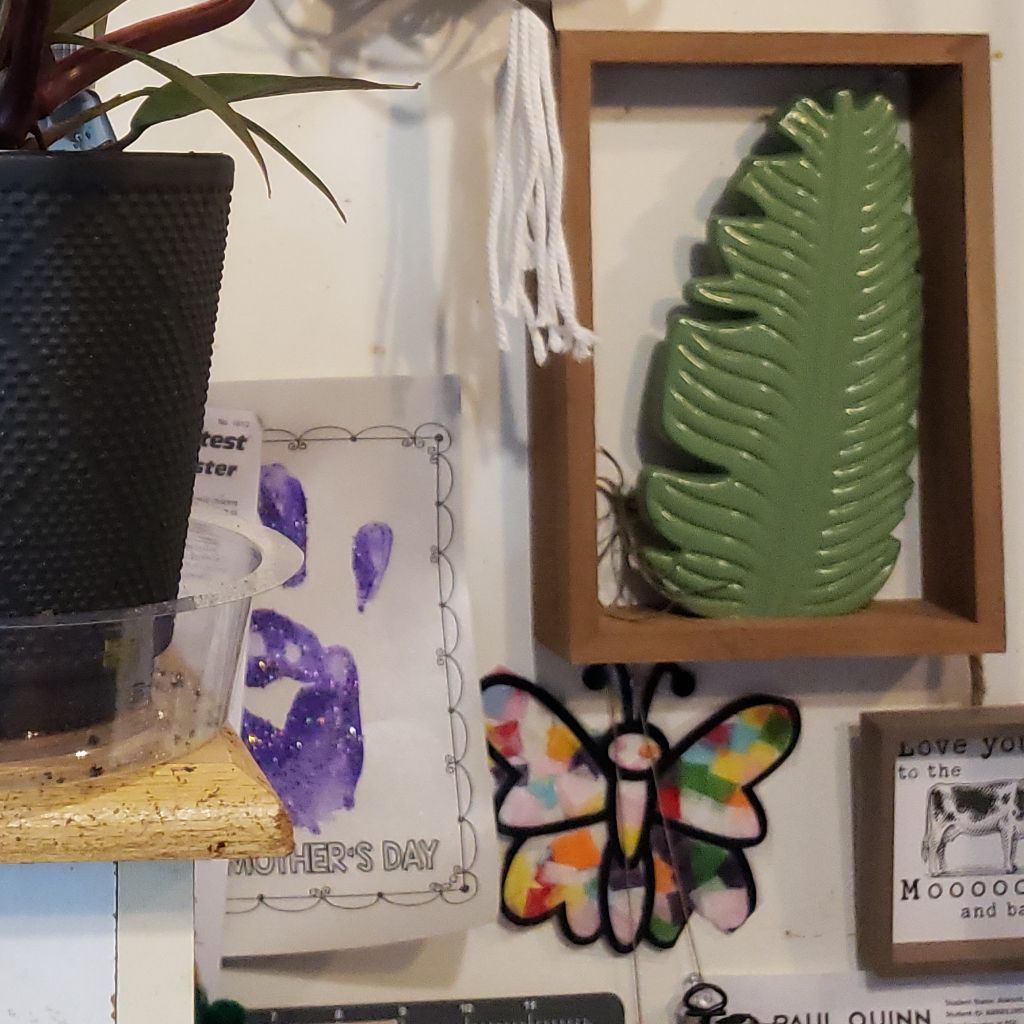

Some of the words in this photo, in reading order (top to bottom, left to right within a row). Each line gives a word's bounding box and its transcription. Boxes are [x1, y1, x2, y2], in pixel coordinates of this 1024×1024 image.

[897, 739, 967, 758] Love
[898, 765, 918, 780] to
[928, 764, 961, 779] the
[382, 838, 440, 872] DAY
[961, 901, 996, 919] and
